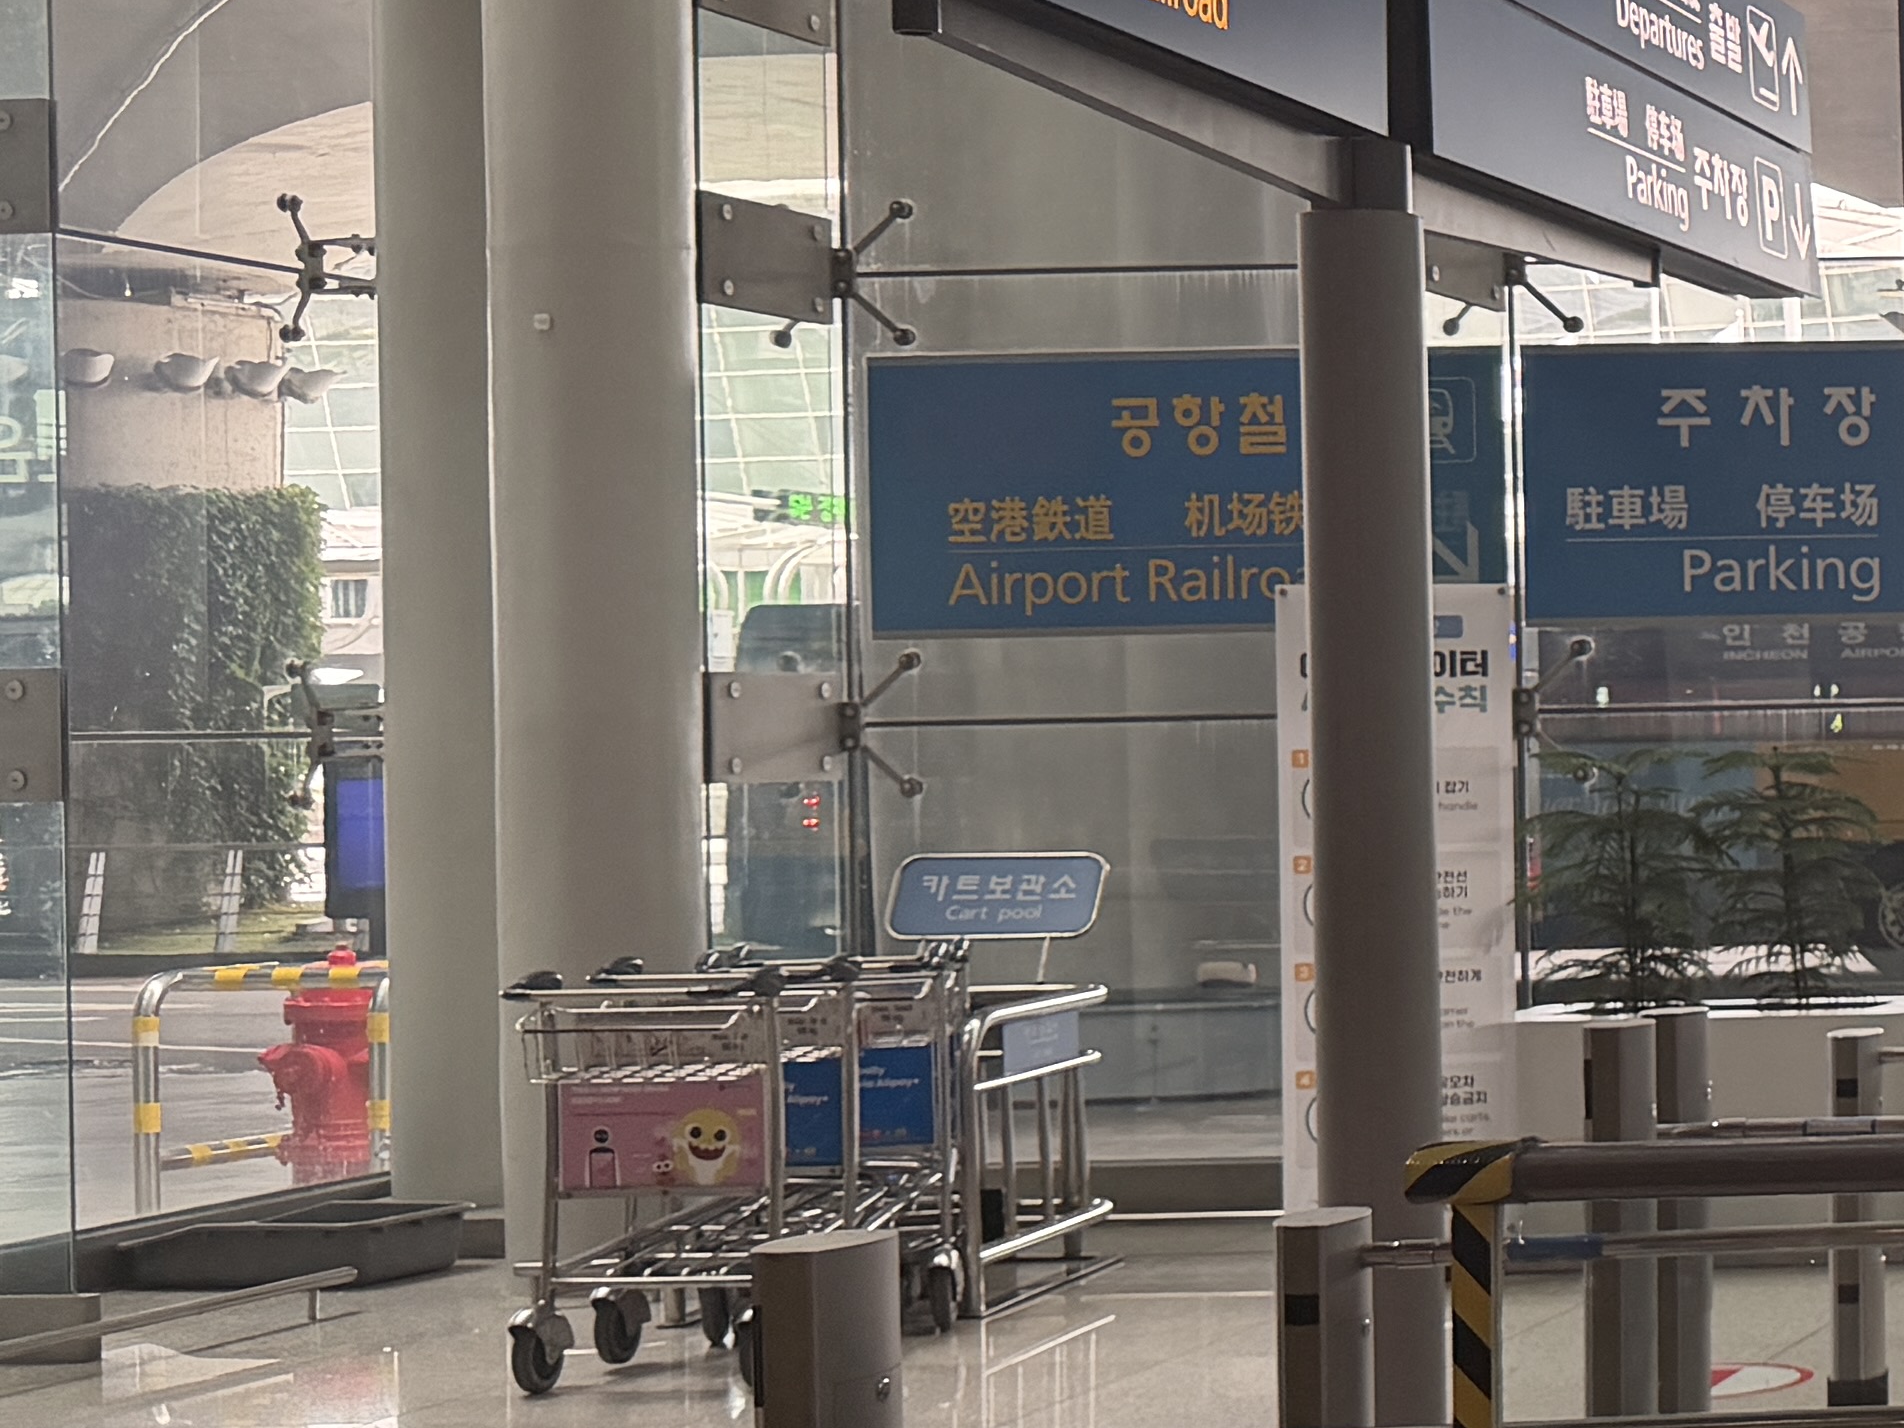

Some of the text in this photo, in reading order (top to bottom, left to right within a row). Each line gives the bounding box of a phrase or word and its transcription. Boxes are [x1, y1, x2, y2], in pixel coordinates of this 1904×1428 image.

[1708, 2, 1744, 73] 출발
[1584, 75, 1685, 163] 駐車場 停车场
[1625, 155, 1690, 232] Parking
[1693, 148, 1749, 228] 주차장
[1656, 383, 1877, 449] 주차장
[948, 495, 1115, 545] 空港鉄道
[1564, 481, 1880, 532] 駐車場 停车场
[949, 561, 1129, 617] Airport
[1682, 548, 1881, 601] Parking
[1722, 622, 1809, 646] 인천
[1723, 648, 1808, 661] INCHEON
[922, 874, 1077, 902] 카트보관소
[945, 905, 1042, 922] Cart pool
